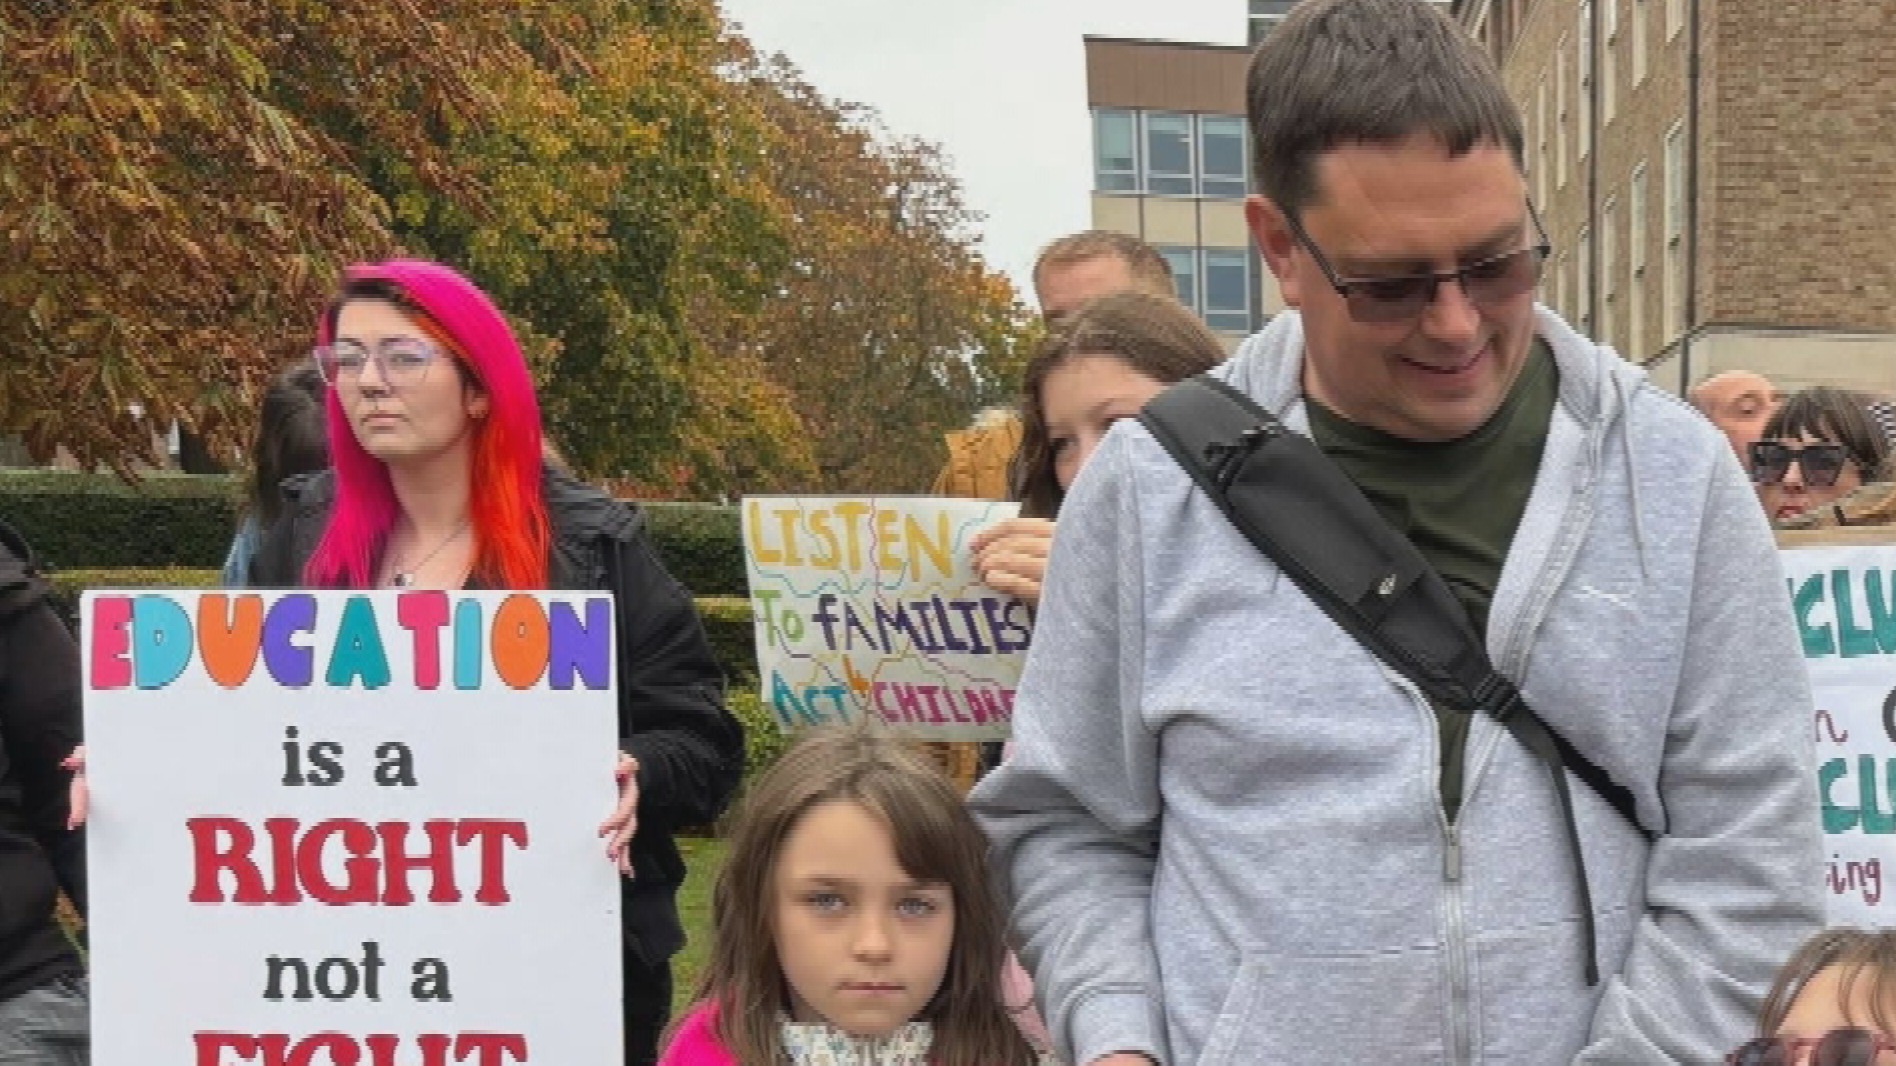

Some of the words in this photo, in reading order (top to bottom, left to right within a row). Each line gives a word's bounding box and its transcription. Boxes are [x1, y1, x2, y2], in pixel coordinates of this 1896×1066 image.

[749, 501, 953, 581] LISTEN
[90, 591, 610, 690] EDUCATION
[772, 669, 848, 726] ACT
[871, 681, 1016, 726] CHILDRE
[281, 726, 344, 787] is
[373, 739, 416, 787] a
[186, 817, 529, 906] RIGHT
[1826, 852, 1881, 907] ing
[263, 942, 385, 1000] not
[412, 956, 451, 1000] a
